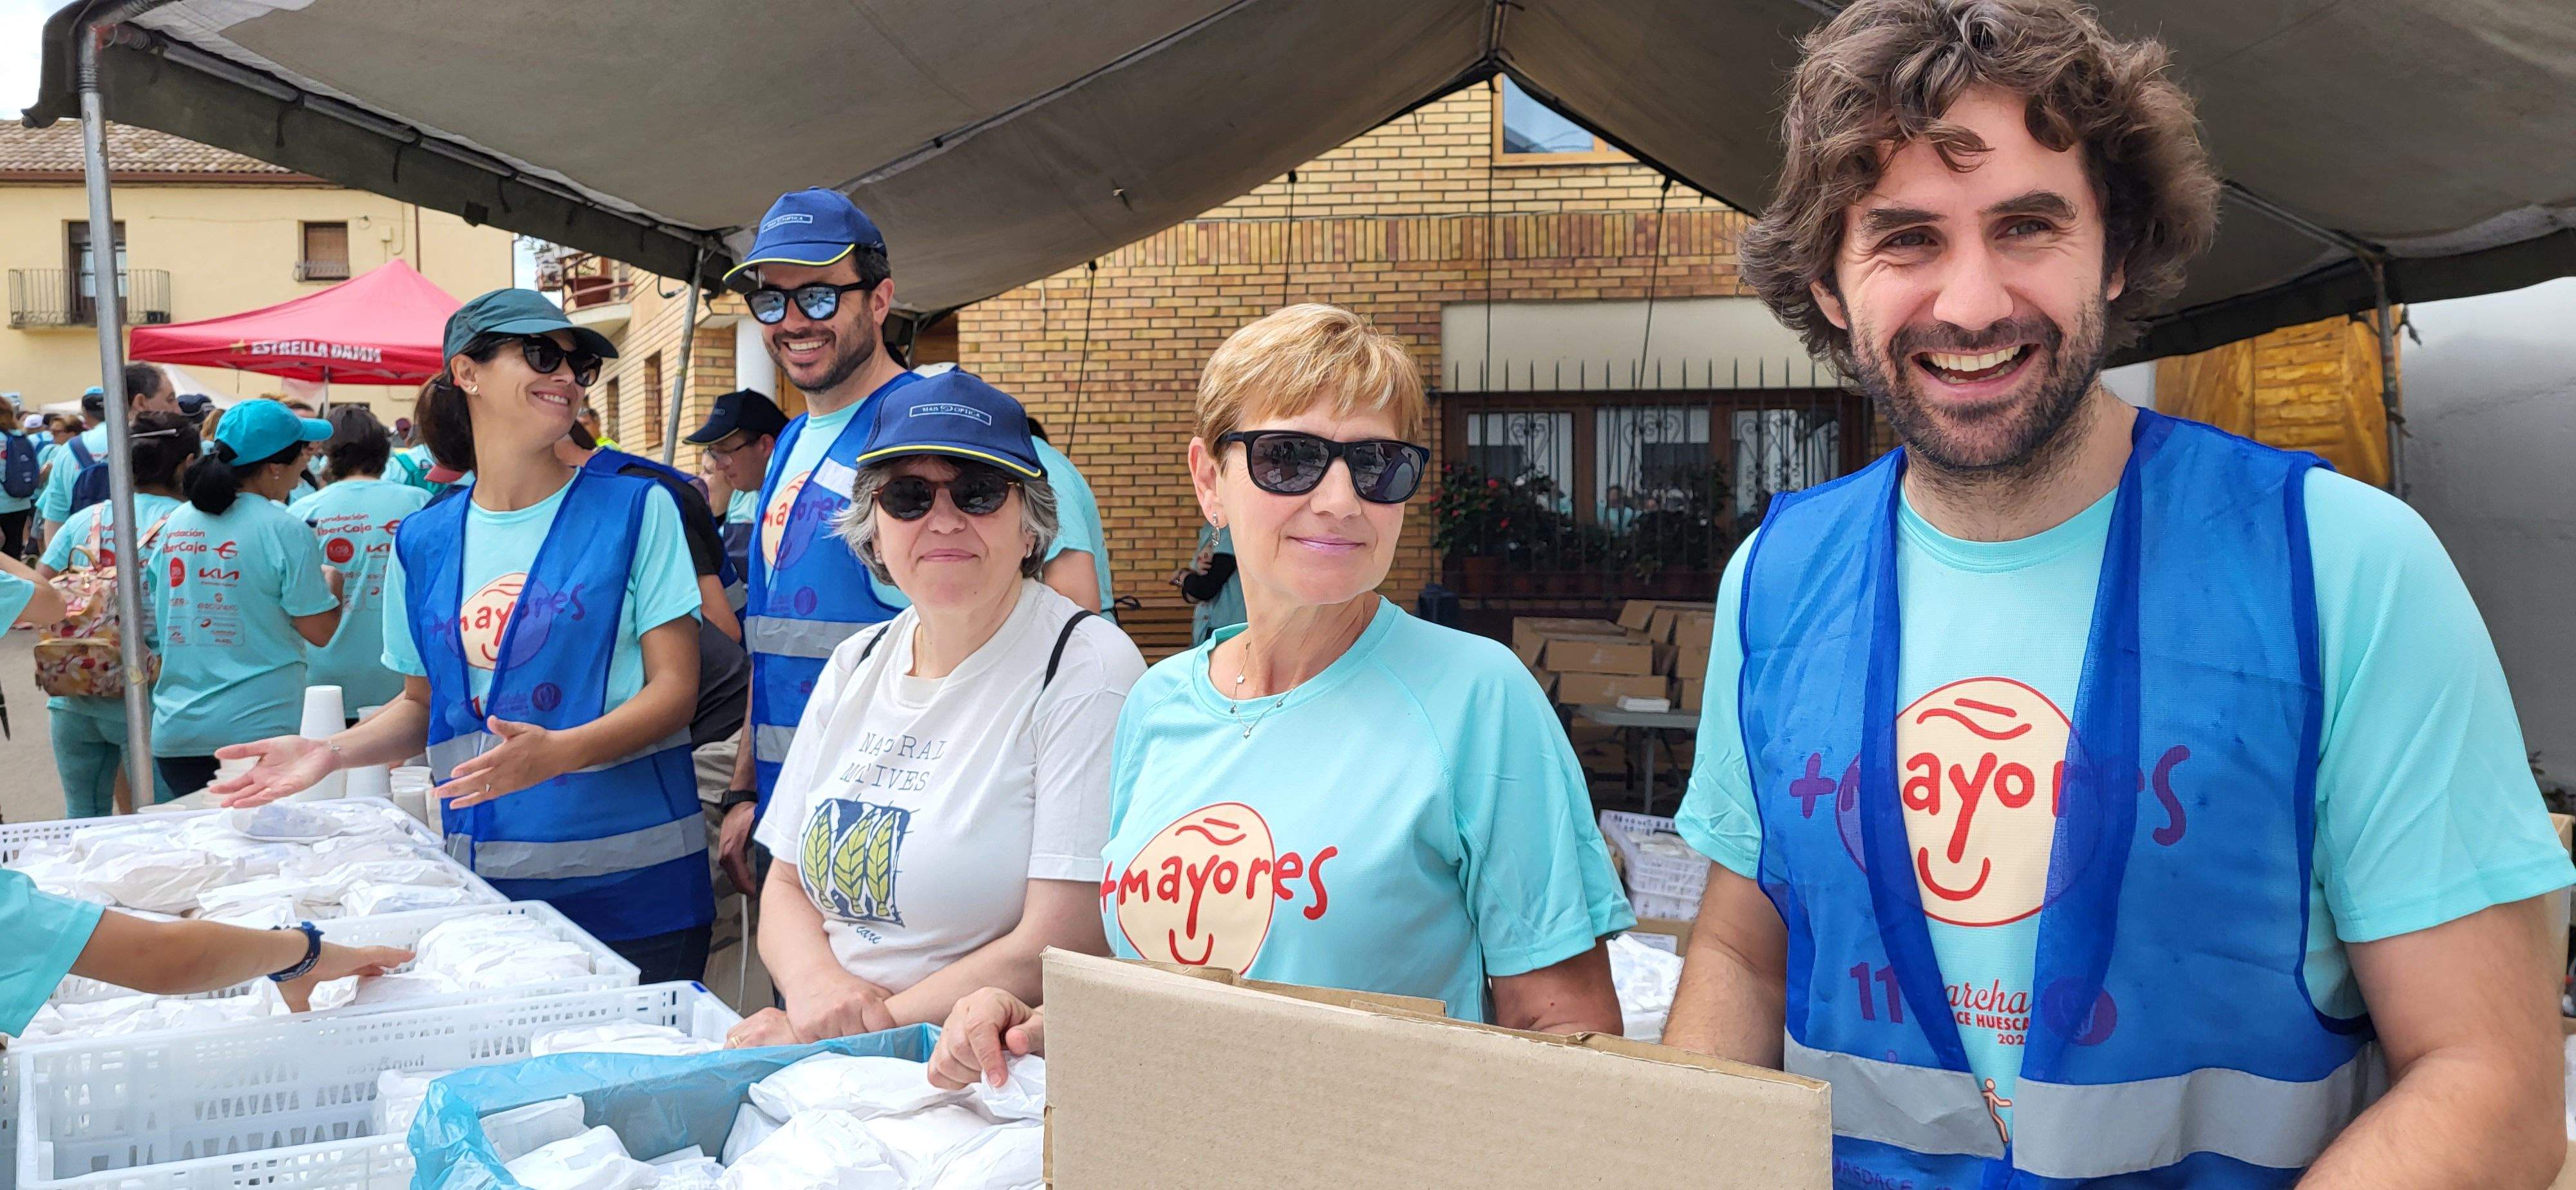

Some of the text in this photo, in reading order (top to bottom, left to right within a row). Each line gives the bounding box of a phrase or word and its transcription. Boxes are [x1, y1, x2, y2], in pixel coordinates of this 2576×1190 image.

[251, 341, 382, 363] ESTRELLA DAMM
[1946, 979, 2032, 1014] archa
